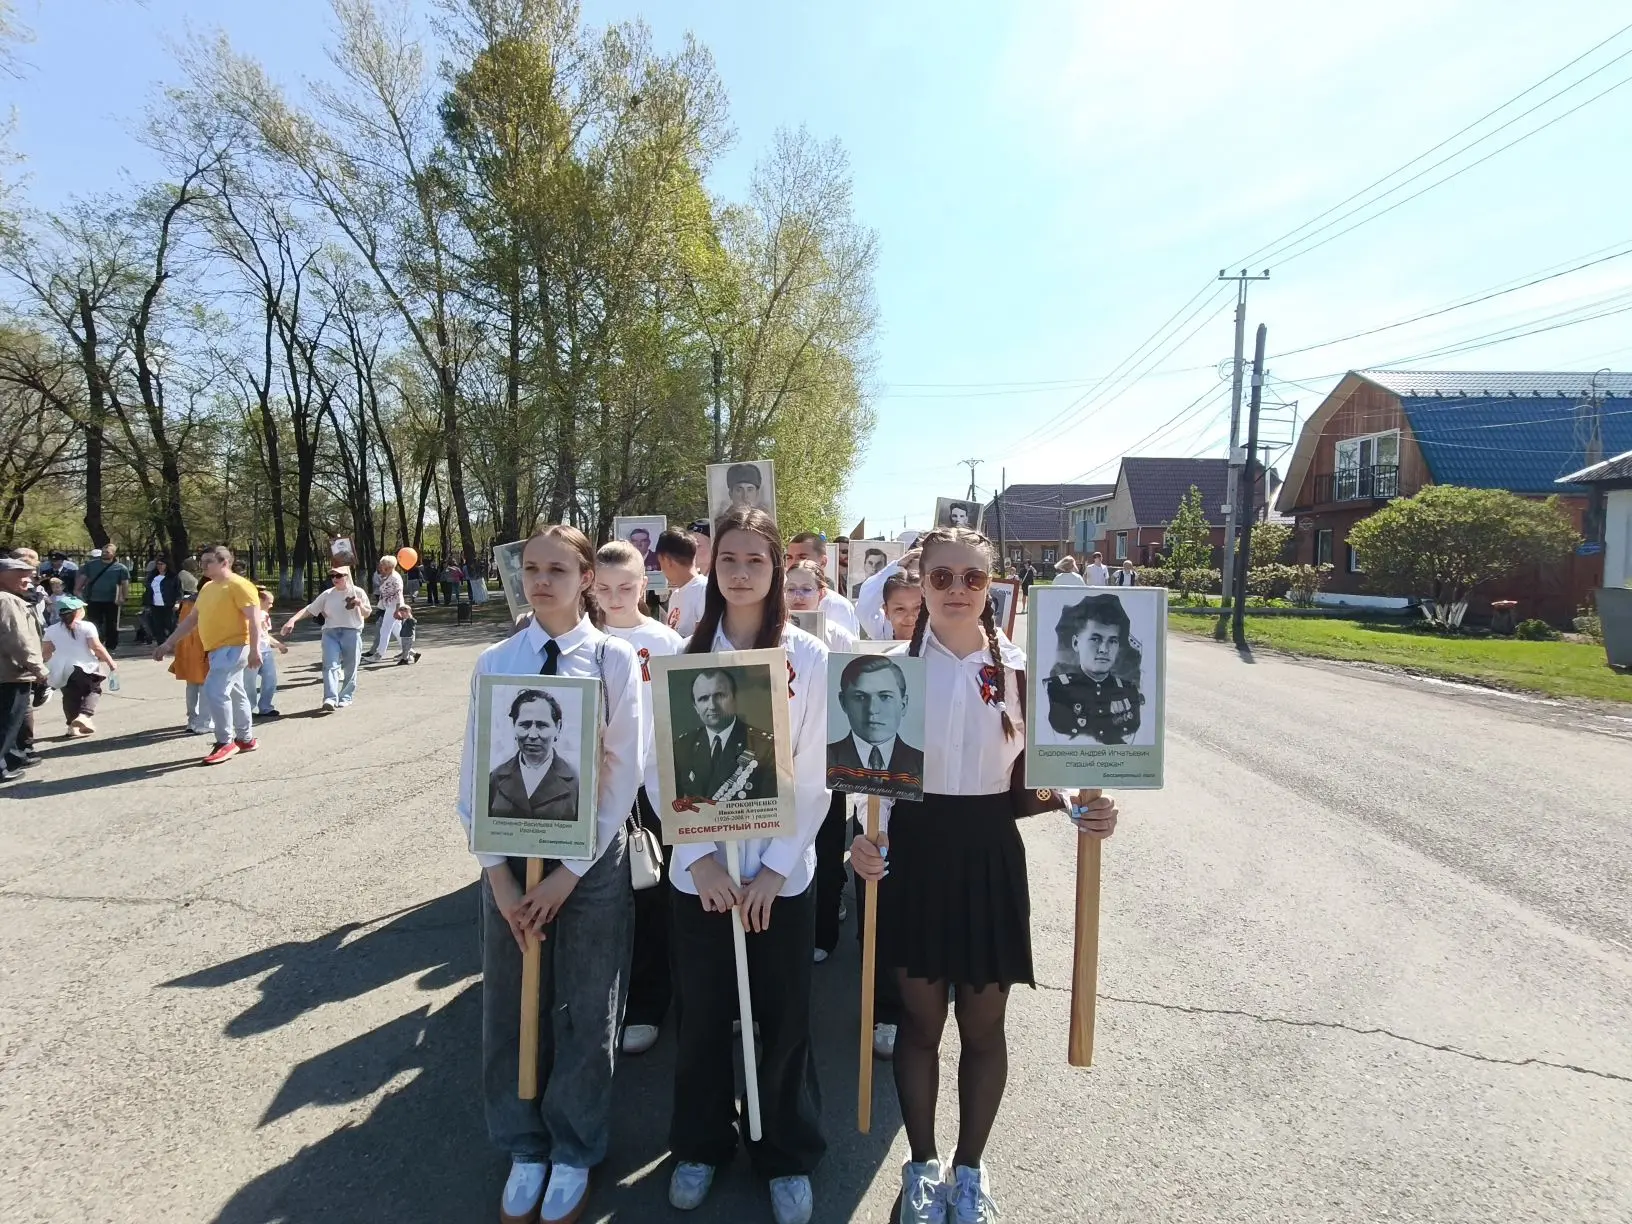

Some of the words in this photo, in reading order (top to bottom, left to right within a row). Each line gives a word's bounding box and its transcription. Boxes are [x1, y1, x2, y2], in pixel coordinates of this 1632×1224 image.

[1038, 750, 1077, 758] Сидоренко
[1080, 749, 1106, 757] Андрей
[1108, 749, 1149, 757] Игнатьевич
[1065, 760, 1095, 768] старший
[726, 799, 777, 809] ПРОКОПЧЕНКО
[678, 822, 751, 835] БЕССМЕРТНЫЙ
[754, 820, 780, 830] ПОЛК
